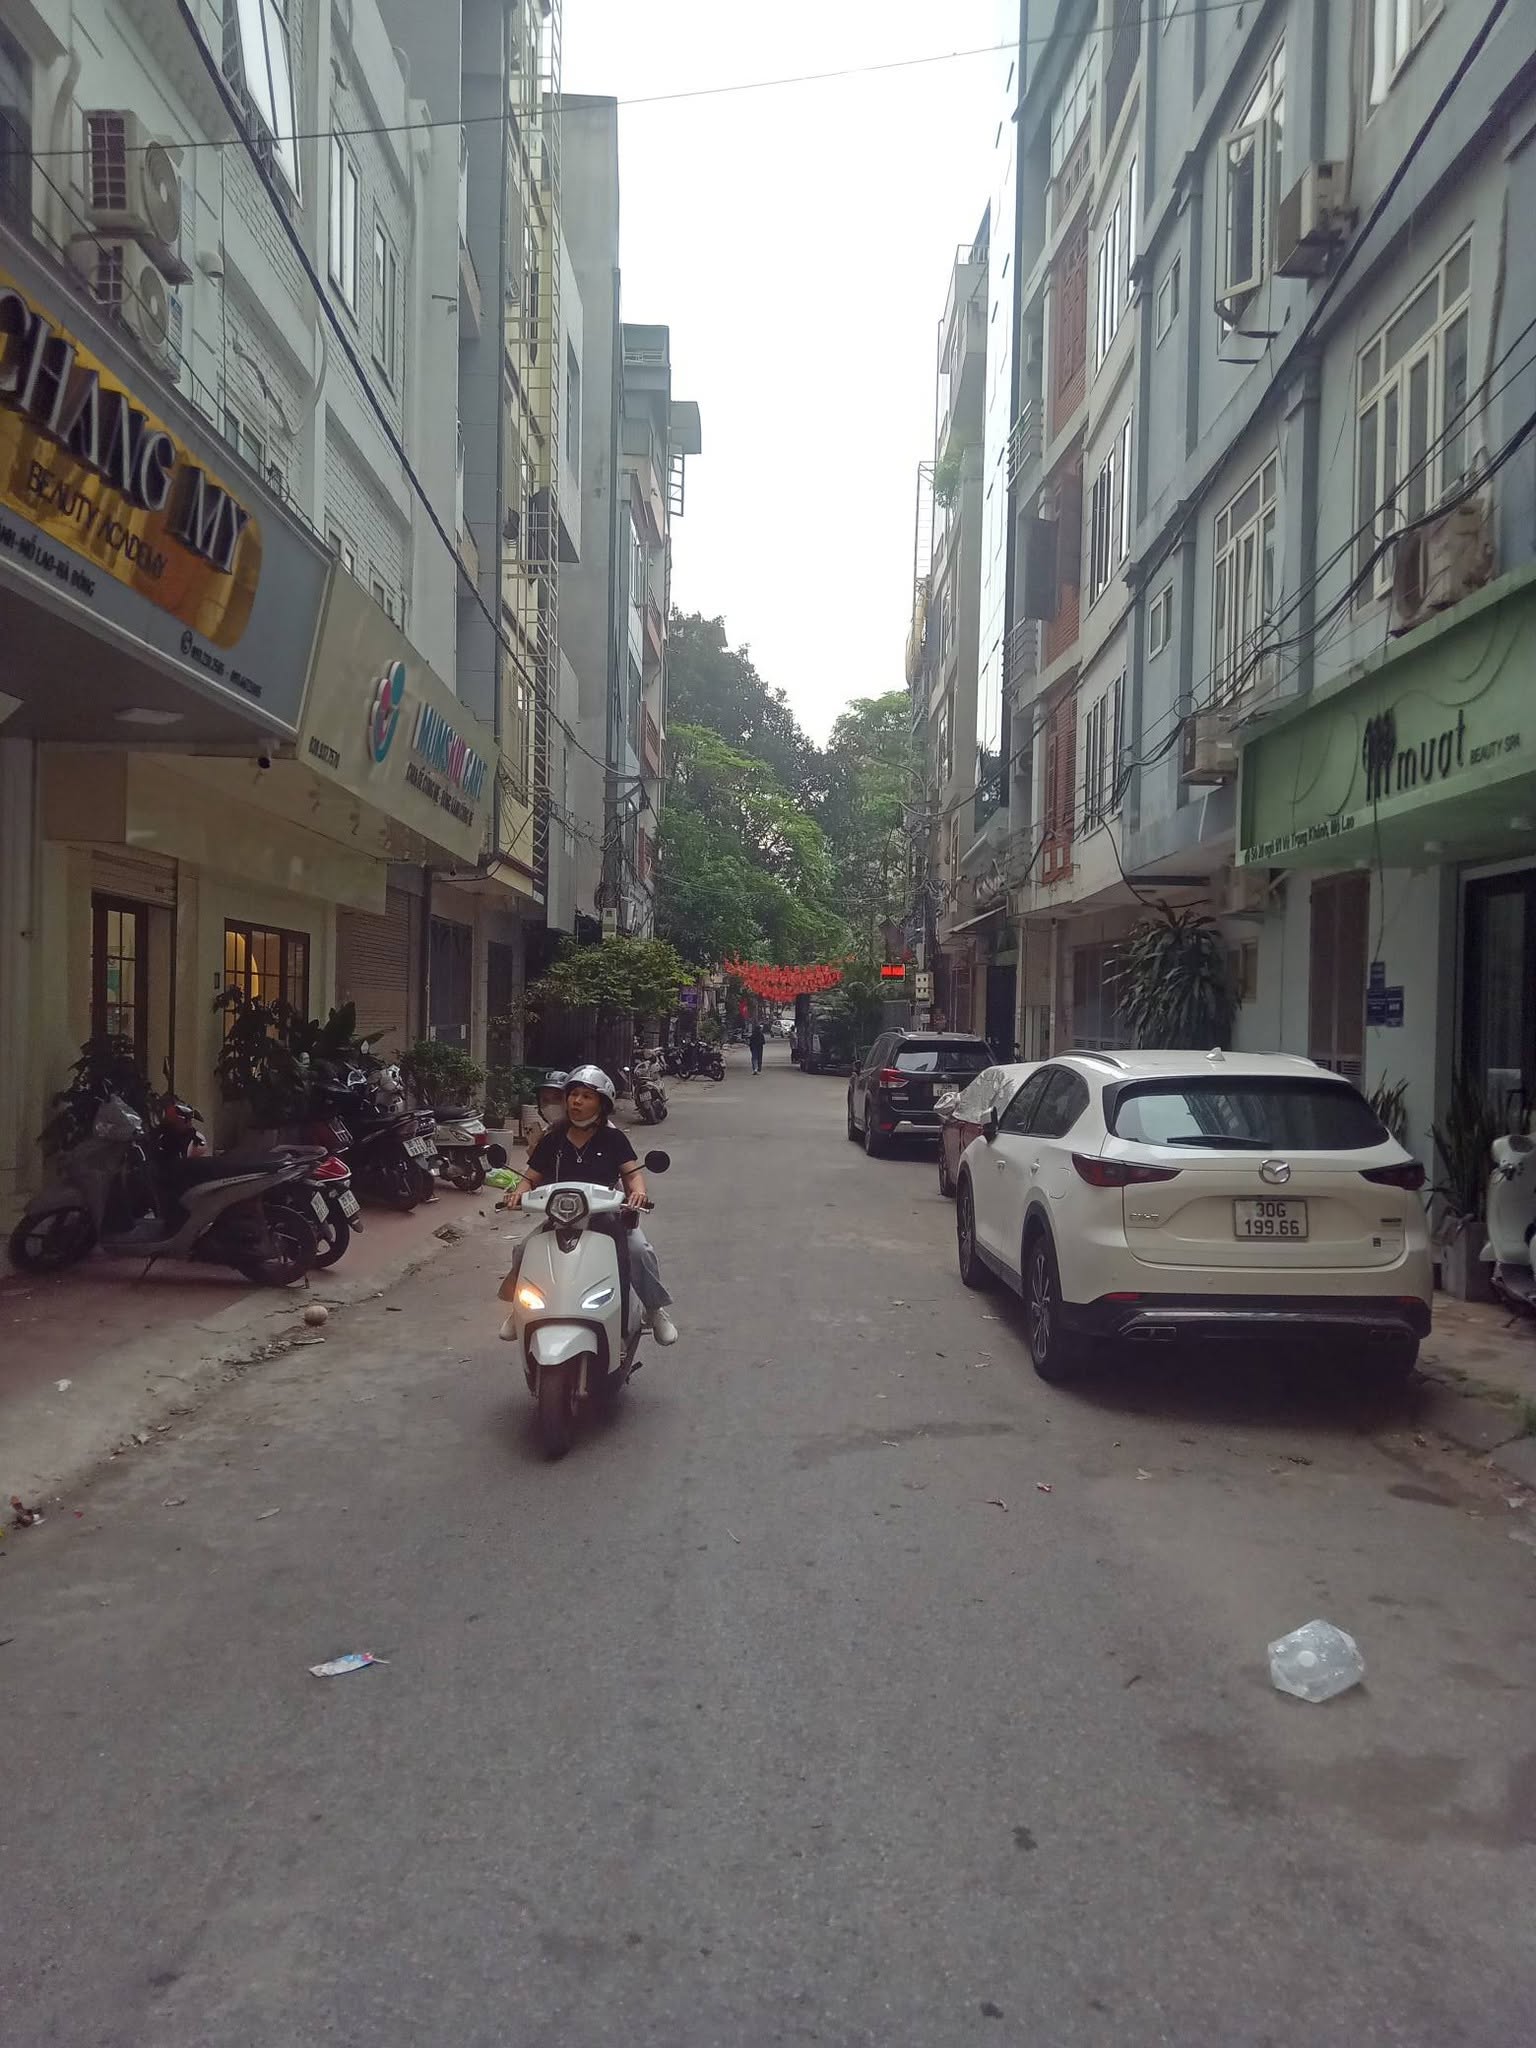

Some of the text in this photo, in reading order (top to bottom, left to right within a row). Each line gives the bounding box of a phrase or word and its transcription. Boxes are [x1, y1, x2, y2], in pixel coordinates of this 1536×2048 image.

[28, 459, 168, 578] BEAUTY ACADEMY
[1470, 733, 1521, 765] BEAUTY SPA
[1256, 1202, 1286, 1218] 30G
[1244, 1219, 1300, 1235] 199.66
